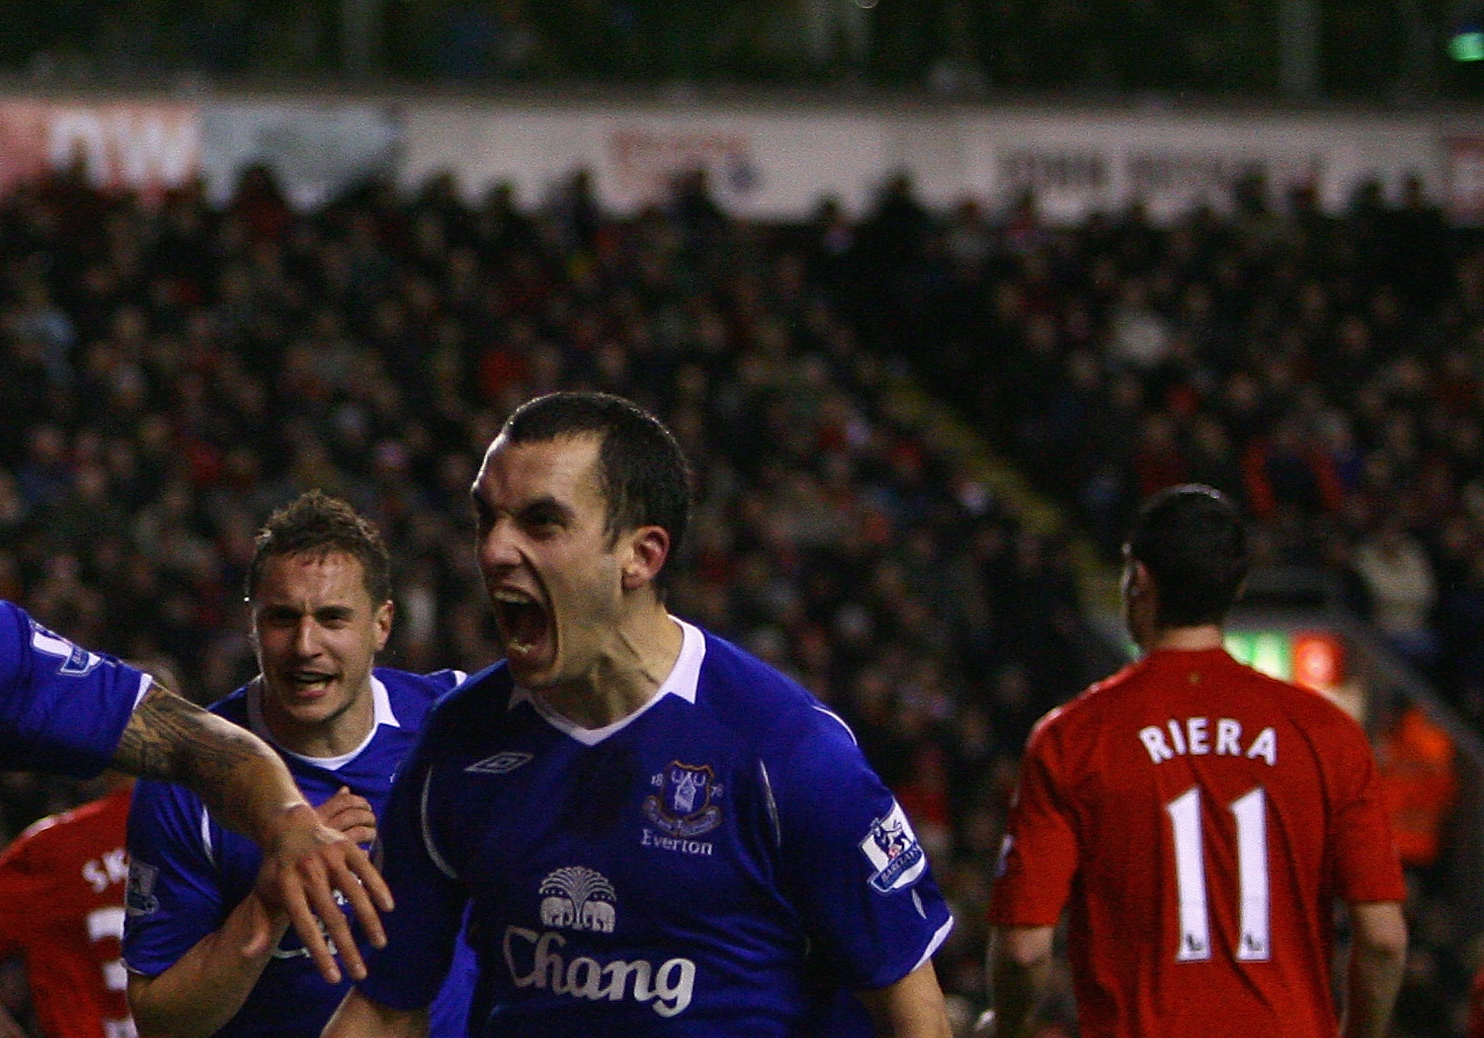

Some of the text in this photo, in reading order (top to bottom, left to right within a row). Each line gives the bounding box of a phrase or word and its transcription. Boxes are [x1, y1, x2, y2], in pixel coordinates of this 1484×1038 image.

[1138, 716, 1278, 766] RIERA
[641, 828, 713, 856] Everton
[1164, 784, 1272, 963] 11
[504, 925, 696, 1018] Chang
